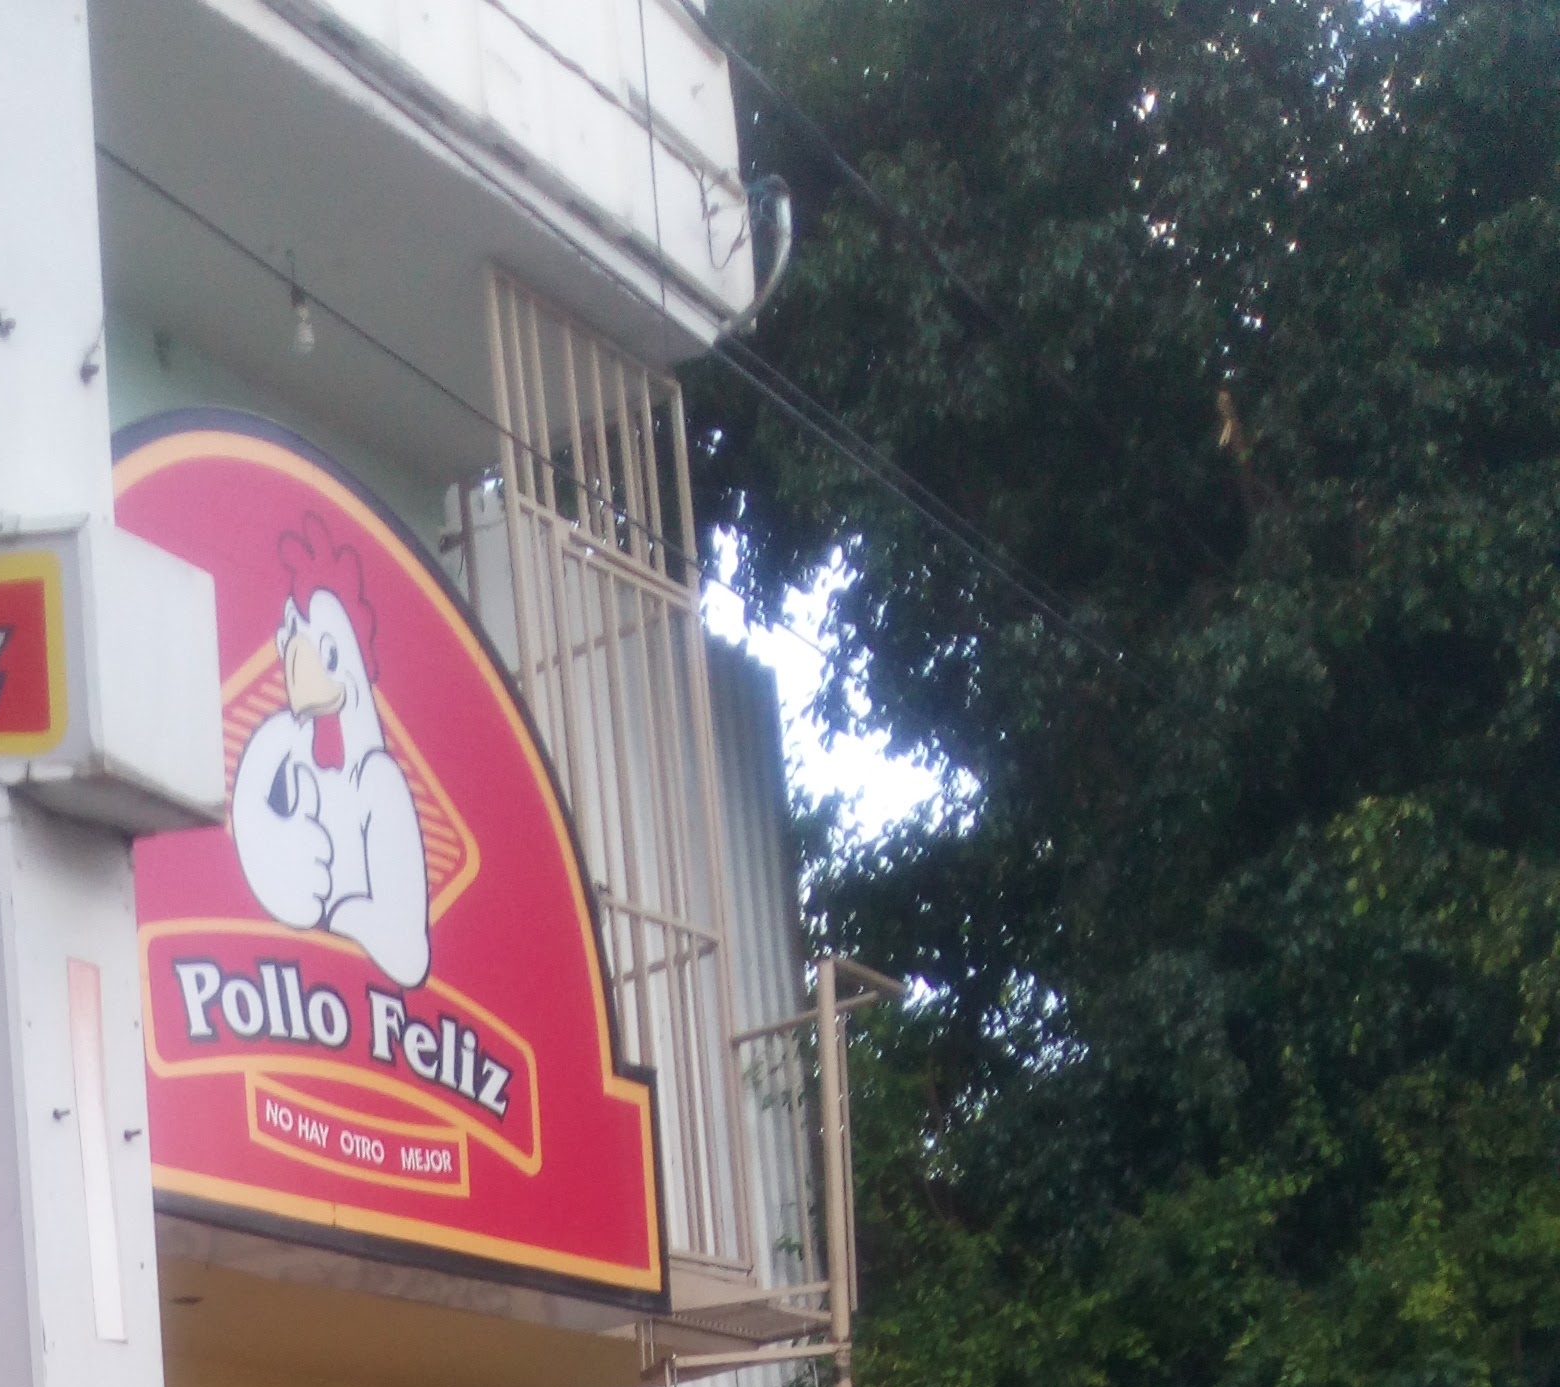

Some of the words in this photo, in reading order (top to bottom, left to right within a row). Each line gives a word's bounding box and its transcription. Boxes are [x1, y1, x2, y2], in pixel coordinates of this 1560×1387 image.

[172, 959, 350, 1049] Pollo
[368, 986, 512, 1120] Feliz
[265, 1099, 294, 1132] NO
[297, 1114, 330, 1150] HAY
[339, 1128, 386, 1164] OTRO
[400, 1146, 453, 1174] MEJOR
